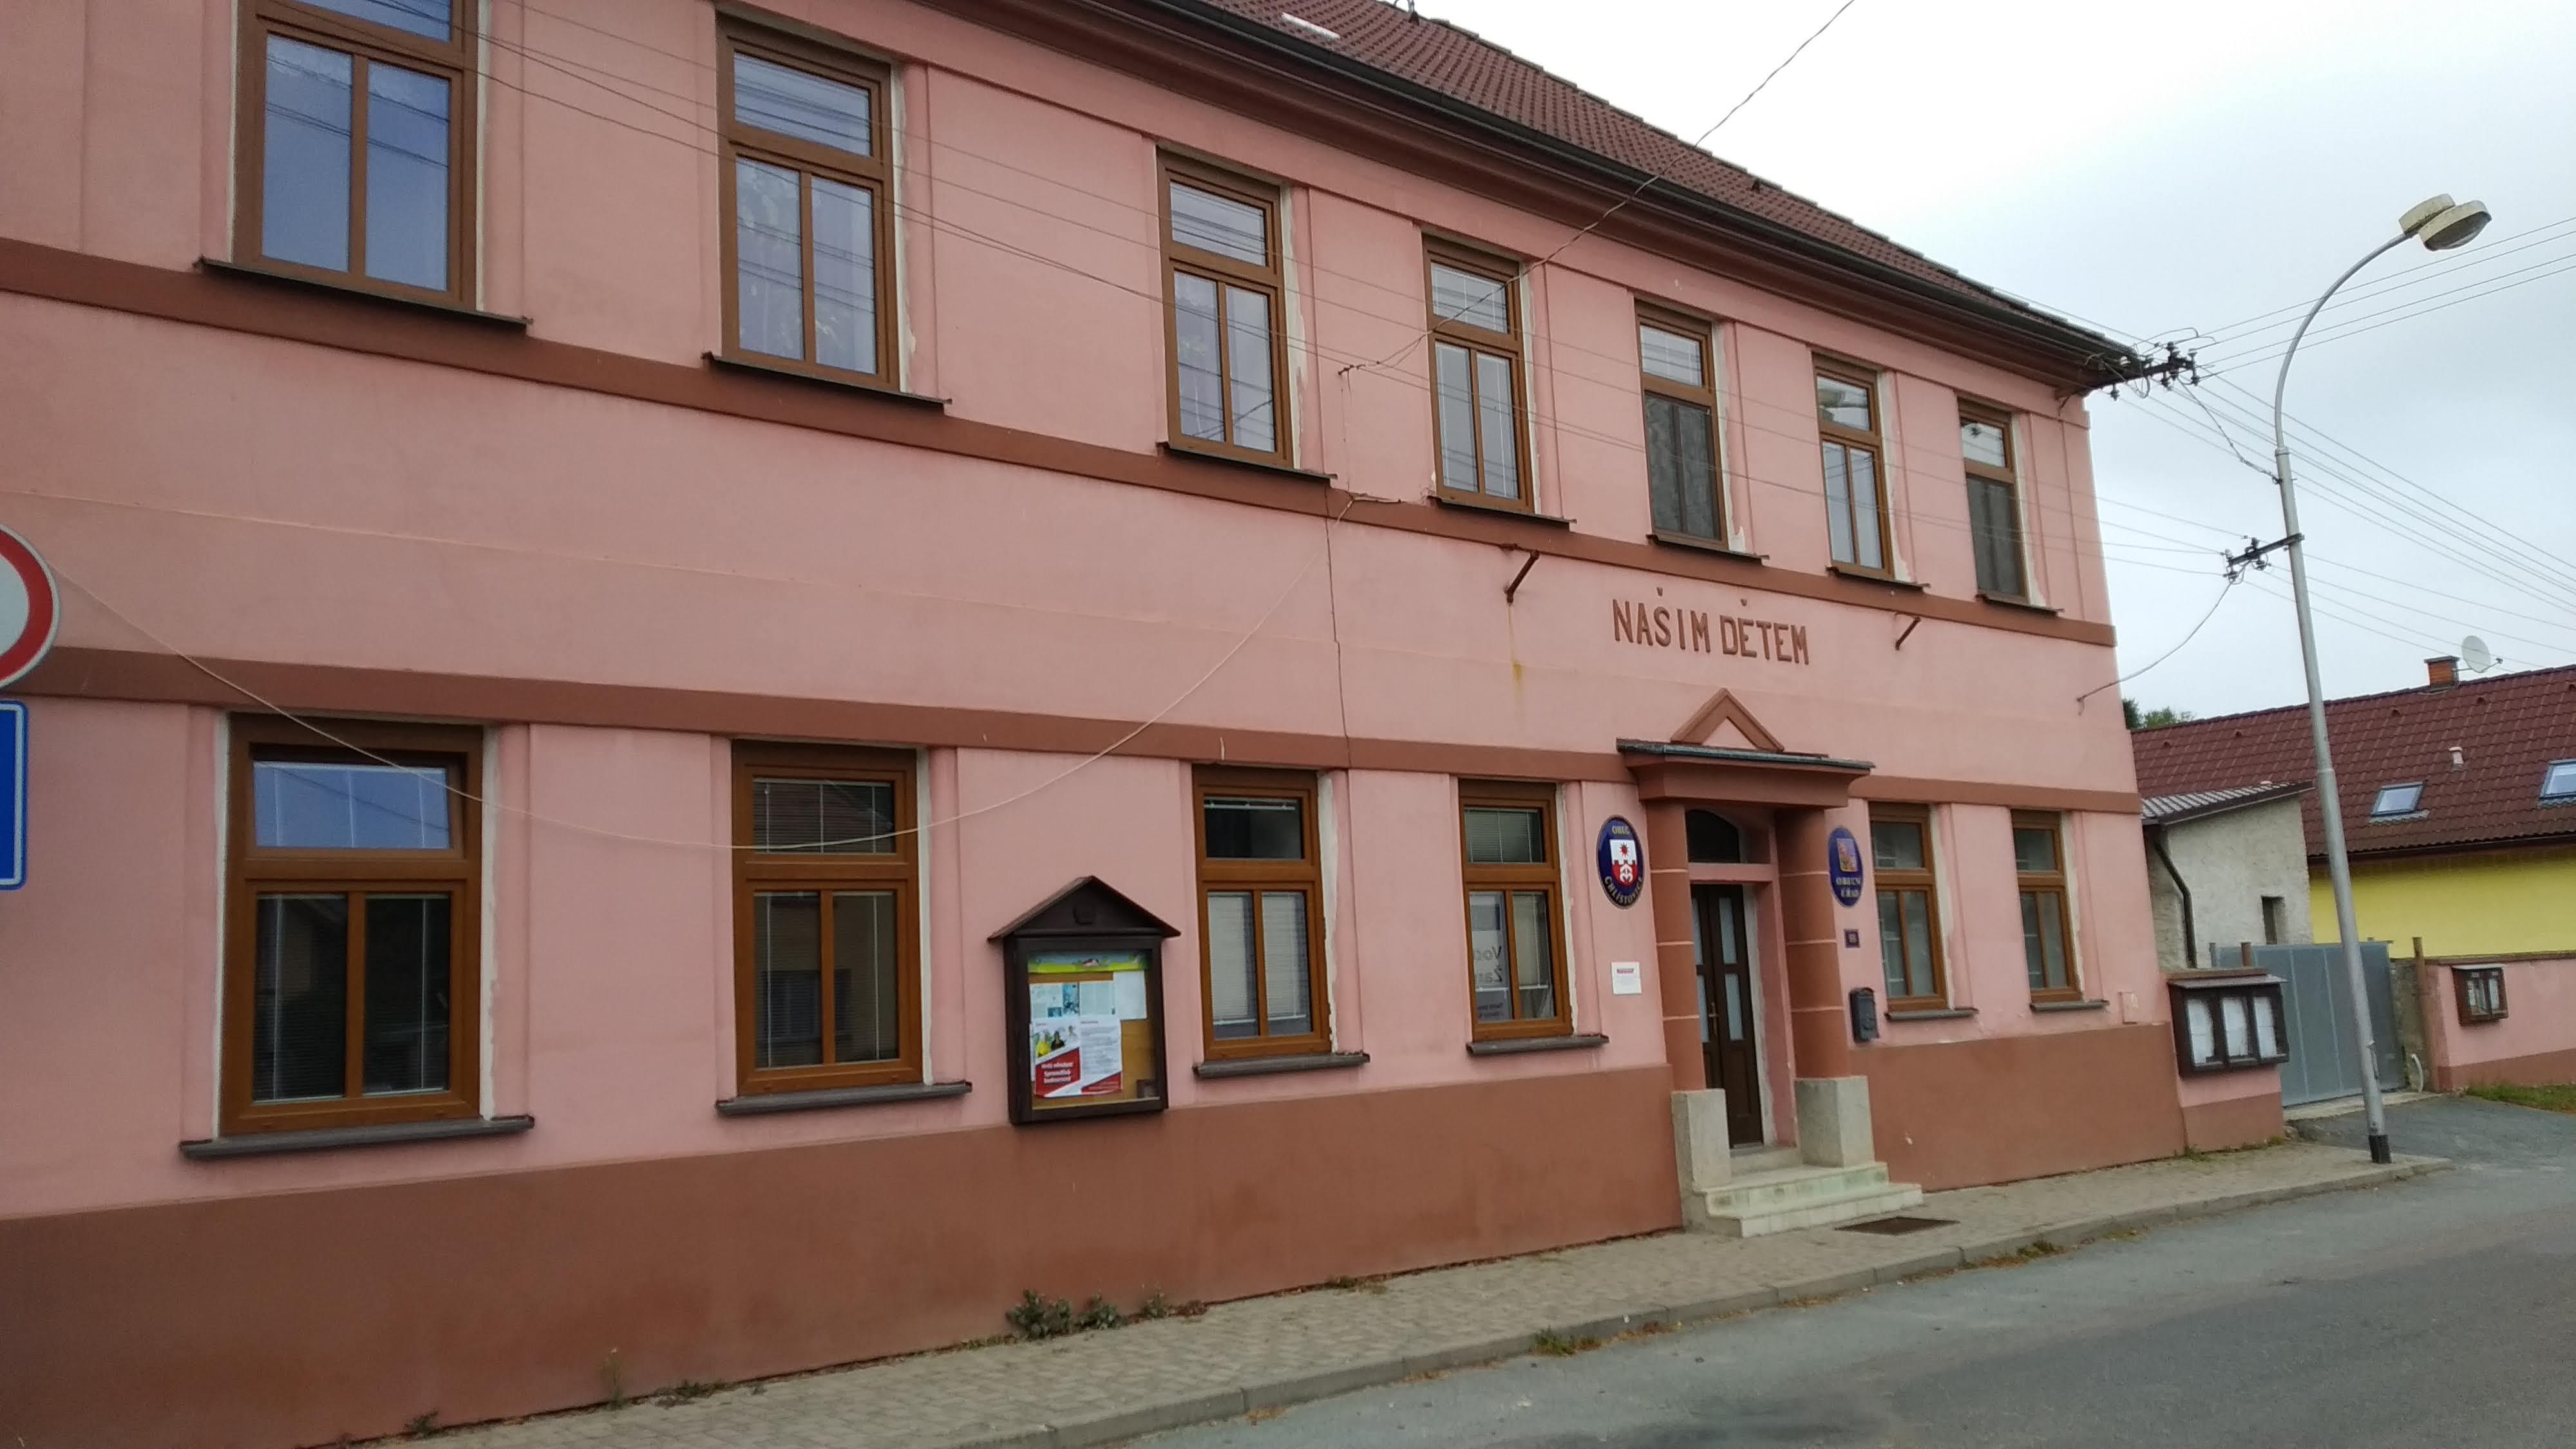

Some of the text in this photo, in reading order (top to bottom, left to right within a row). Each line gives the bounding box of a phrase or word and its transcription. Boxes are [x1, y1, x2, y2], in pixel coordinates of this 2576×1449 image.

[1613, 587, 1809, 665] NAŠIM DĚTEM
[1611, 825, 1630, 835] OBEC
